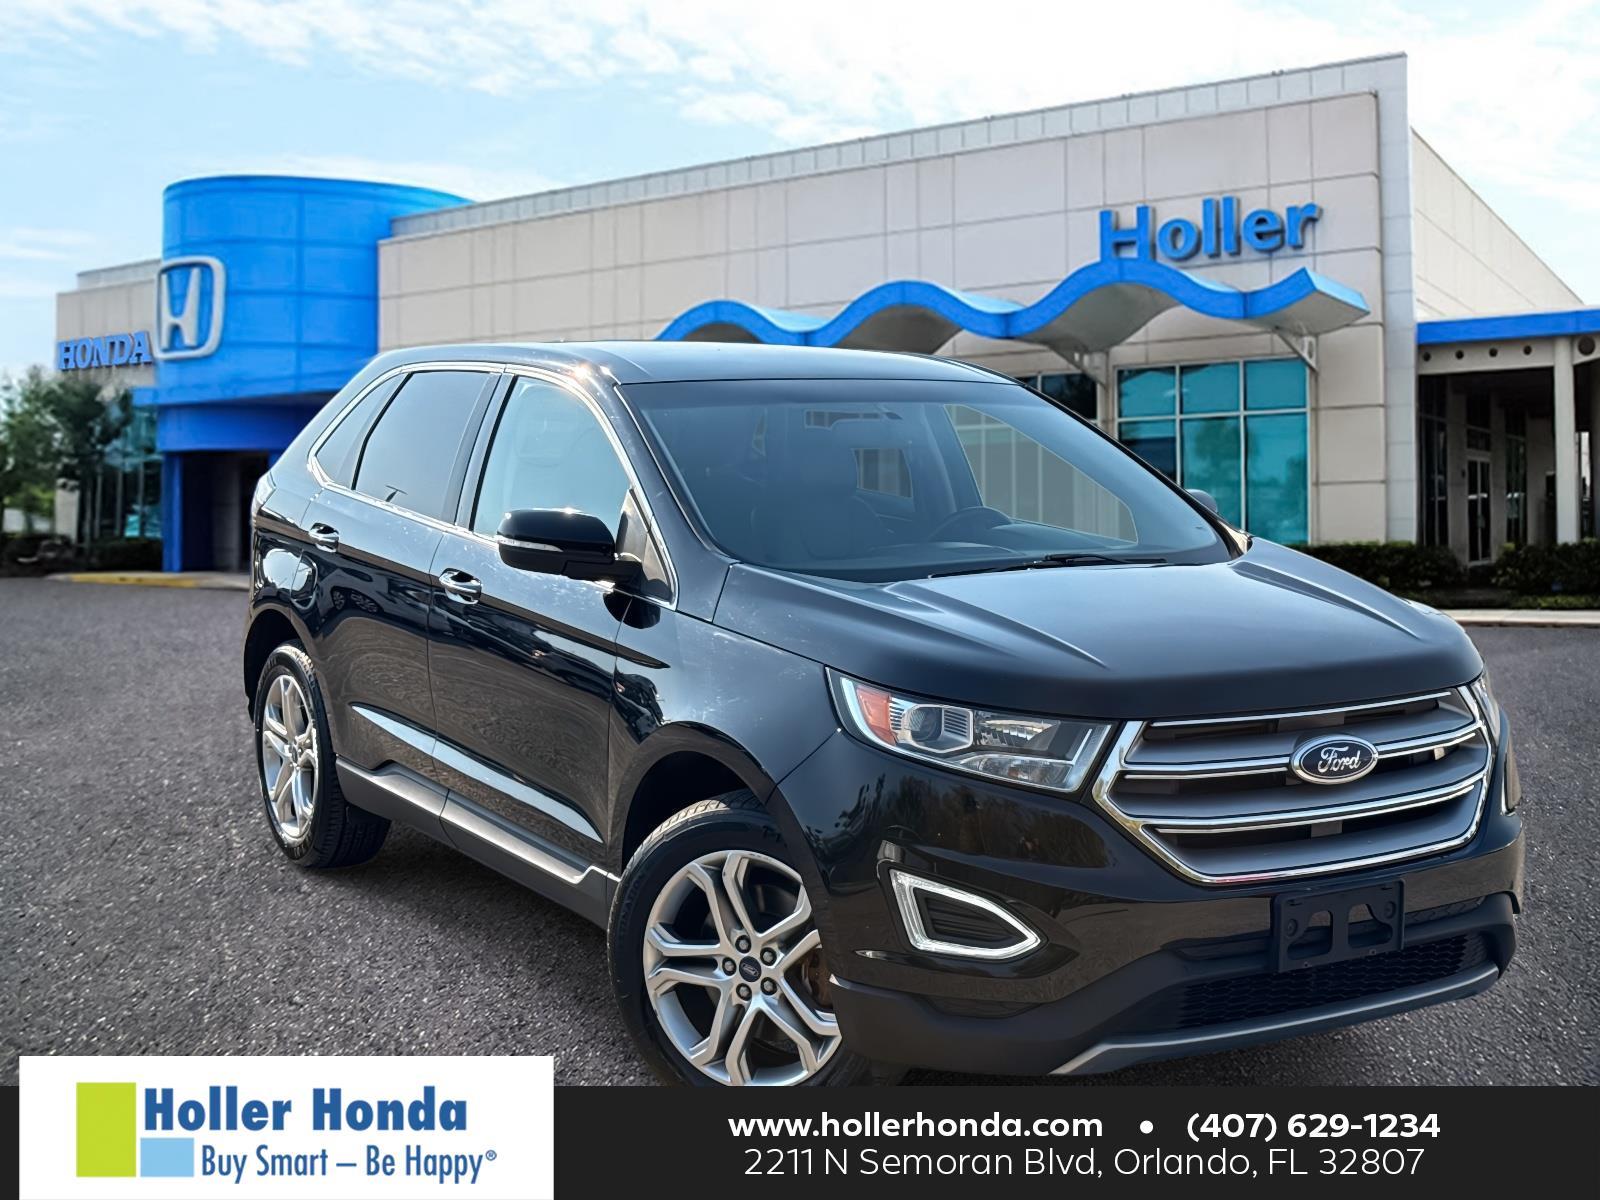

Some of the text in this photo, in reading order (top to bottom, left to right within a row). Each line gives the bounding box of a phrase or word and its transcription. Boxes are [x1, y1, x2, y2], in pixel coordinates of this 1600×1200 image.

[1099, 196, 1322, 262] Holler
[57, 331, 152, 370] HONDA
[1318, 746, 1361, 773] Ford
